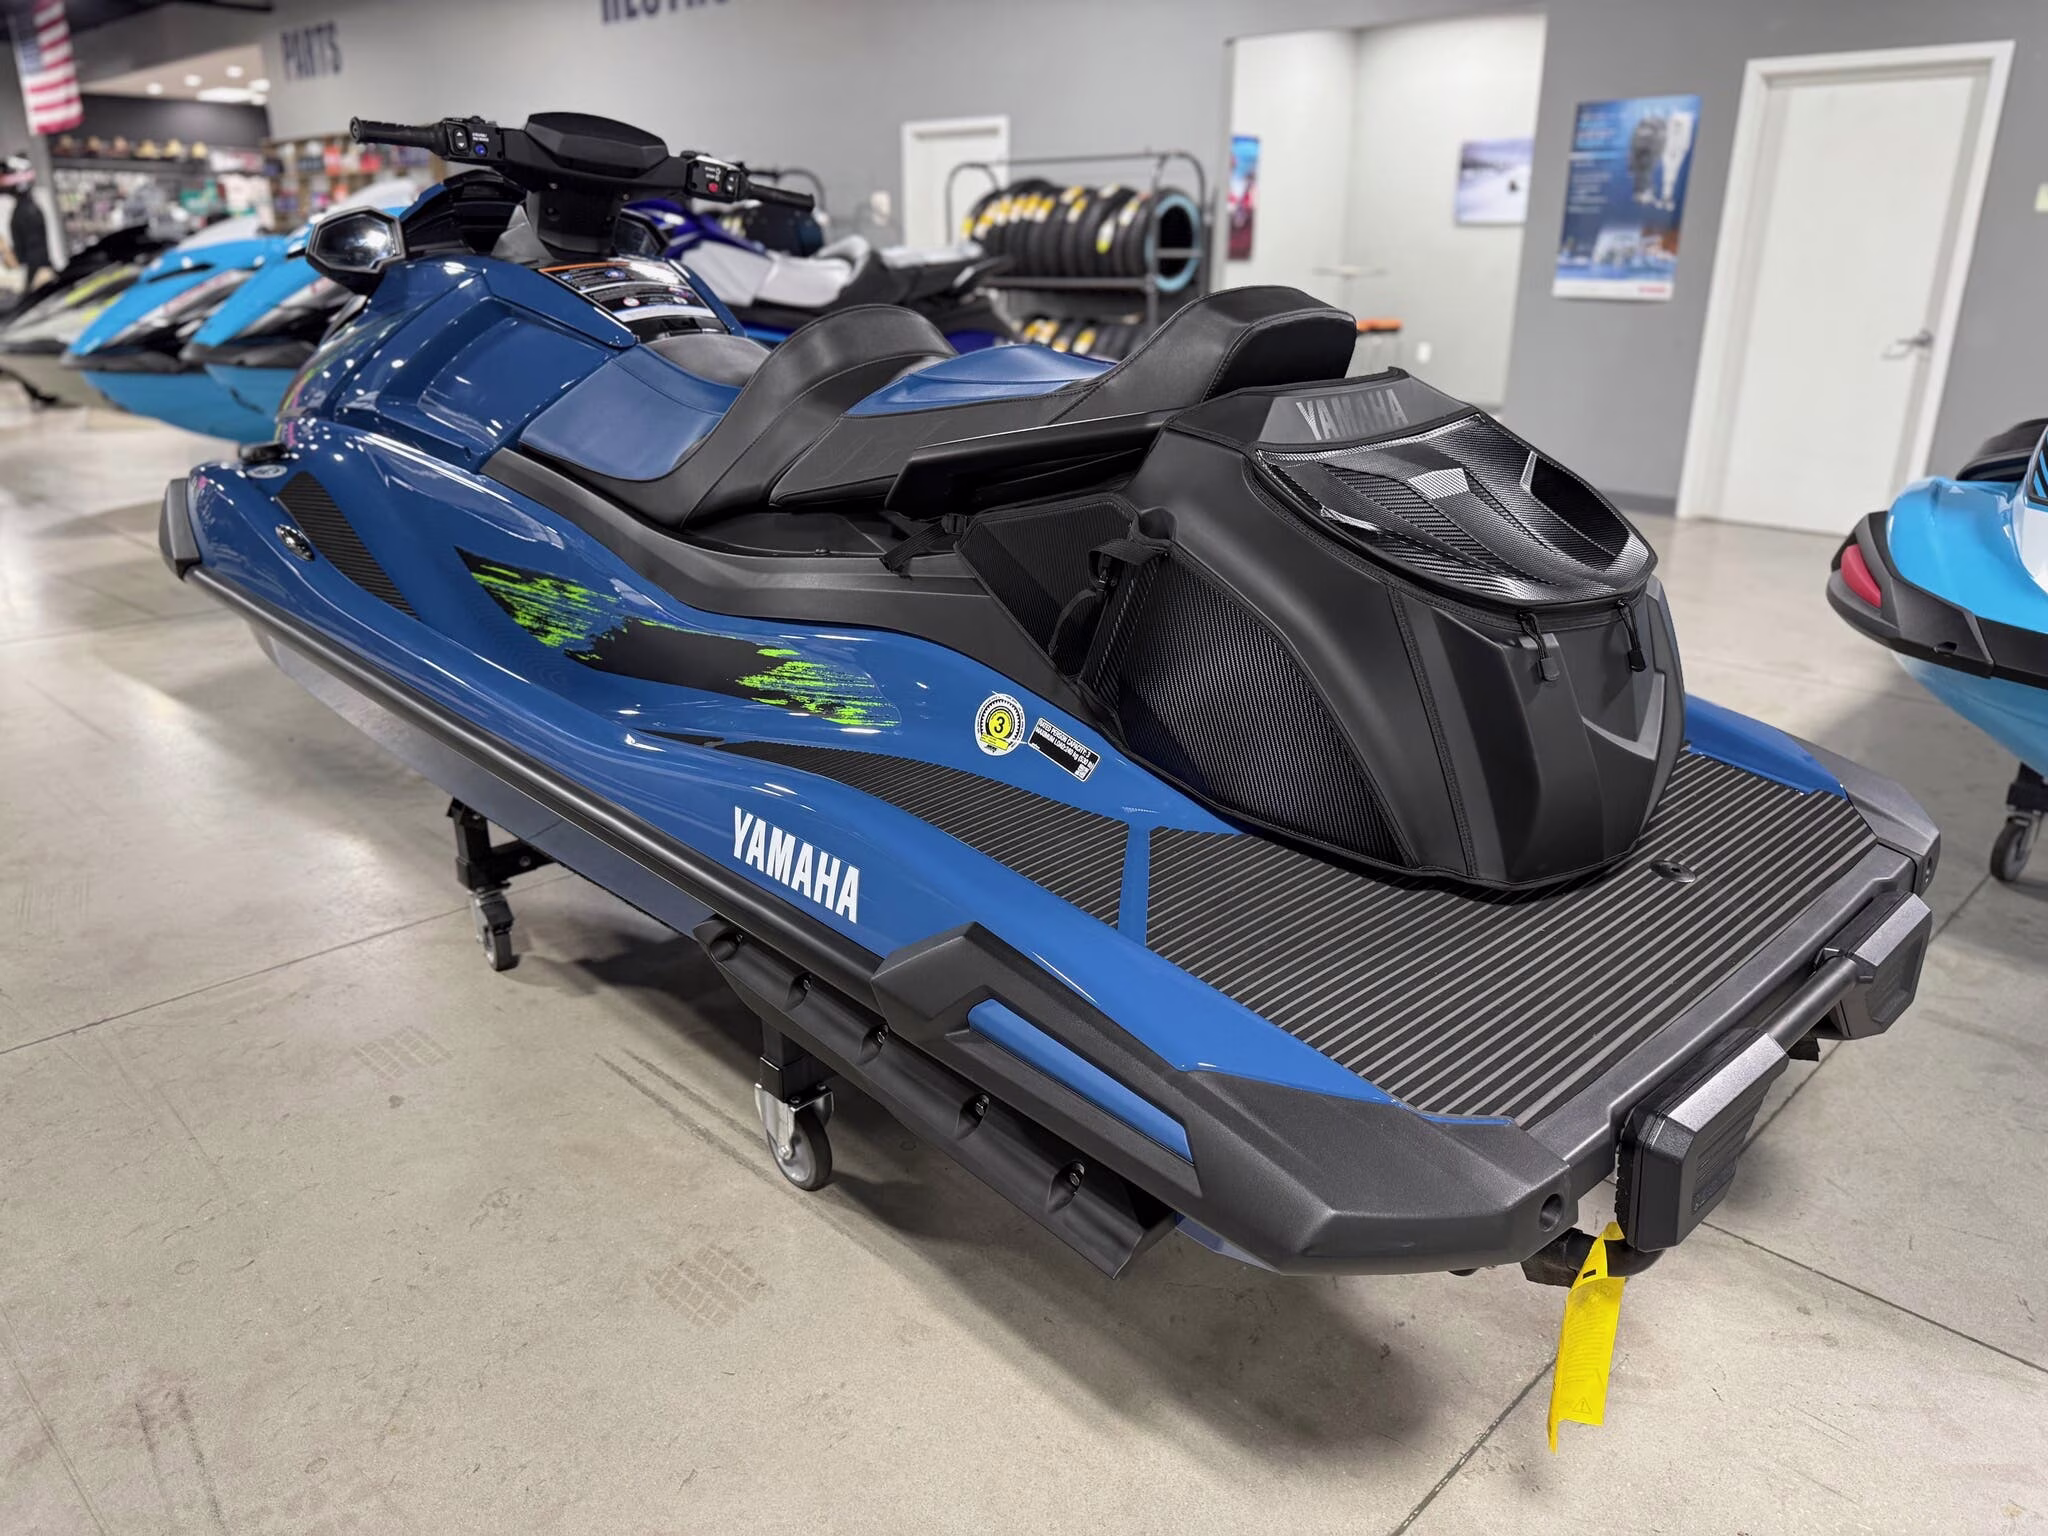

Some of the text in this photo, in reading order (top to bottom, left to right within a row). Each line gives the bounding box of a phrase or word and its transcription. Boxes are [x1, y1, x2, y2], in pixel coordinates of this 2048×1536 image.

[283, 20, 341, 79] PARTS
[1297, 389, 1408, 440] YAMAHA
[993, 716, 1006, 734] 3
[733, 805, 860, 924] YAMAHA
